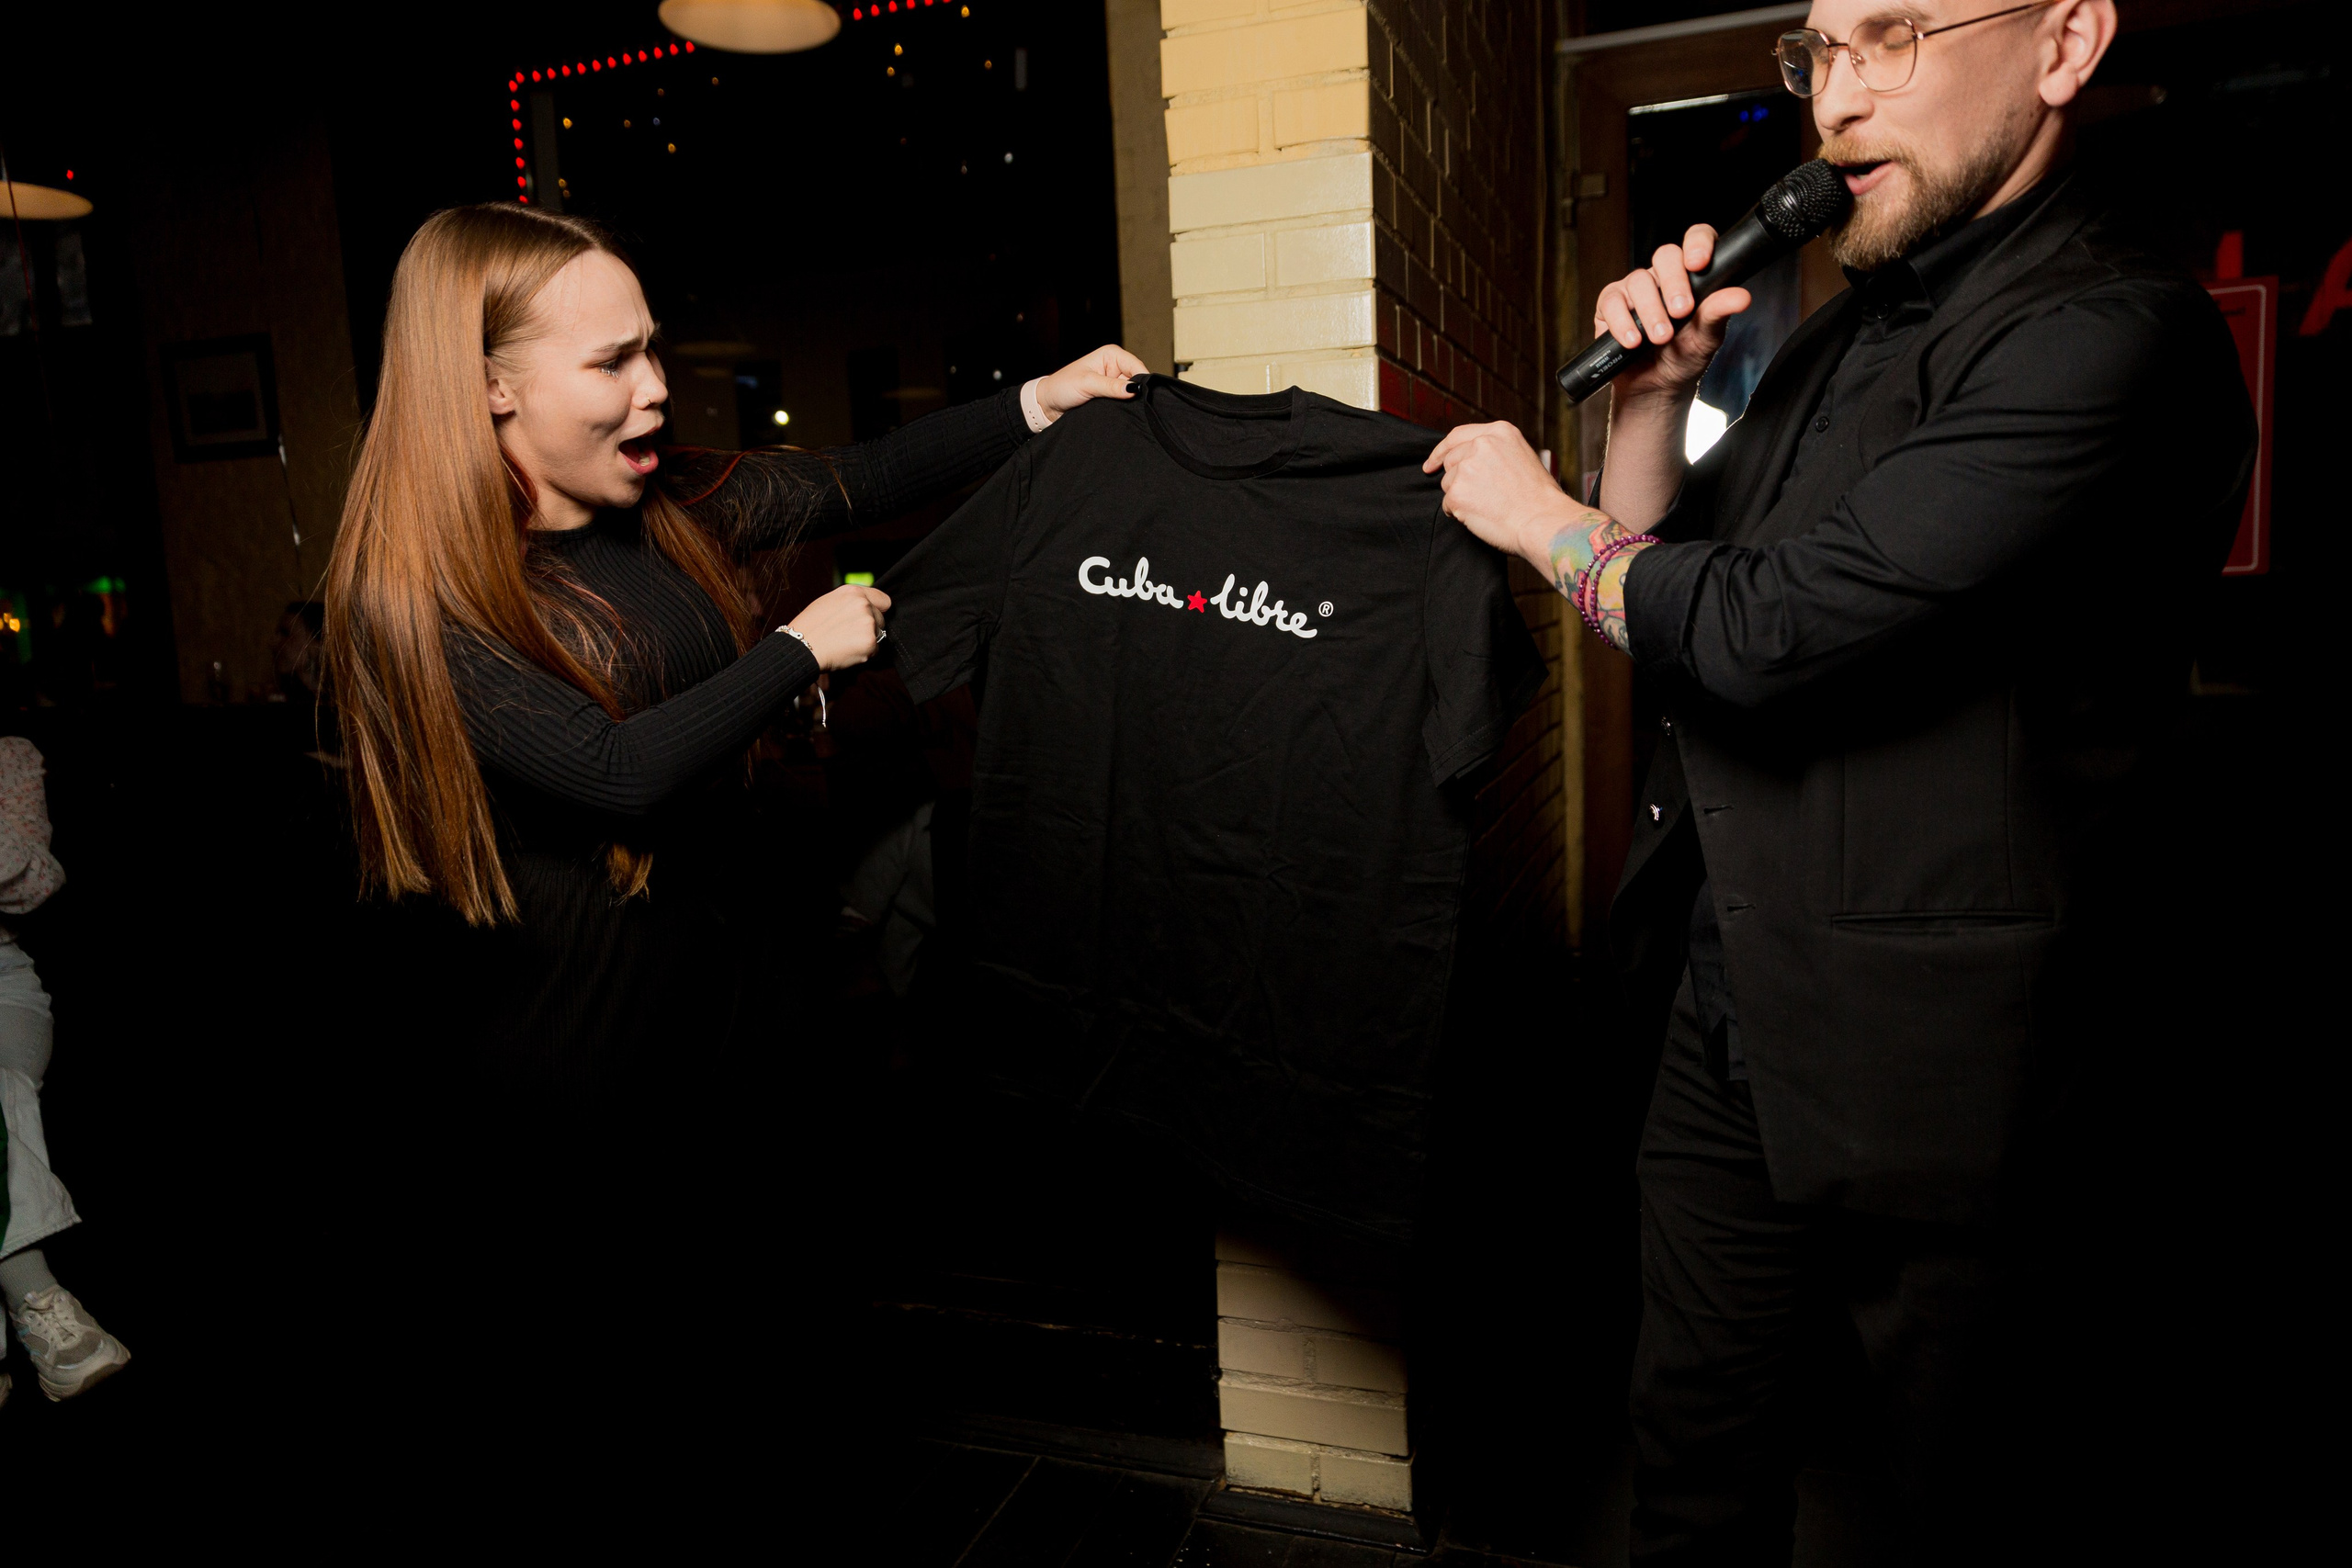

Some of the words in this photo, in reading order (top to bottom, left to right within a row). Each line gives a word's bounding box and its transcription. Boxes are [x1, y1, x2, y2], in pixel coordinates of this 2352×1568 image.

[1598, 354, 1623, 373] PROEL
[1078, 556, 1184, 609] Cuba
[1209, 573, 1317, 638] libre
